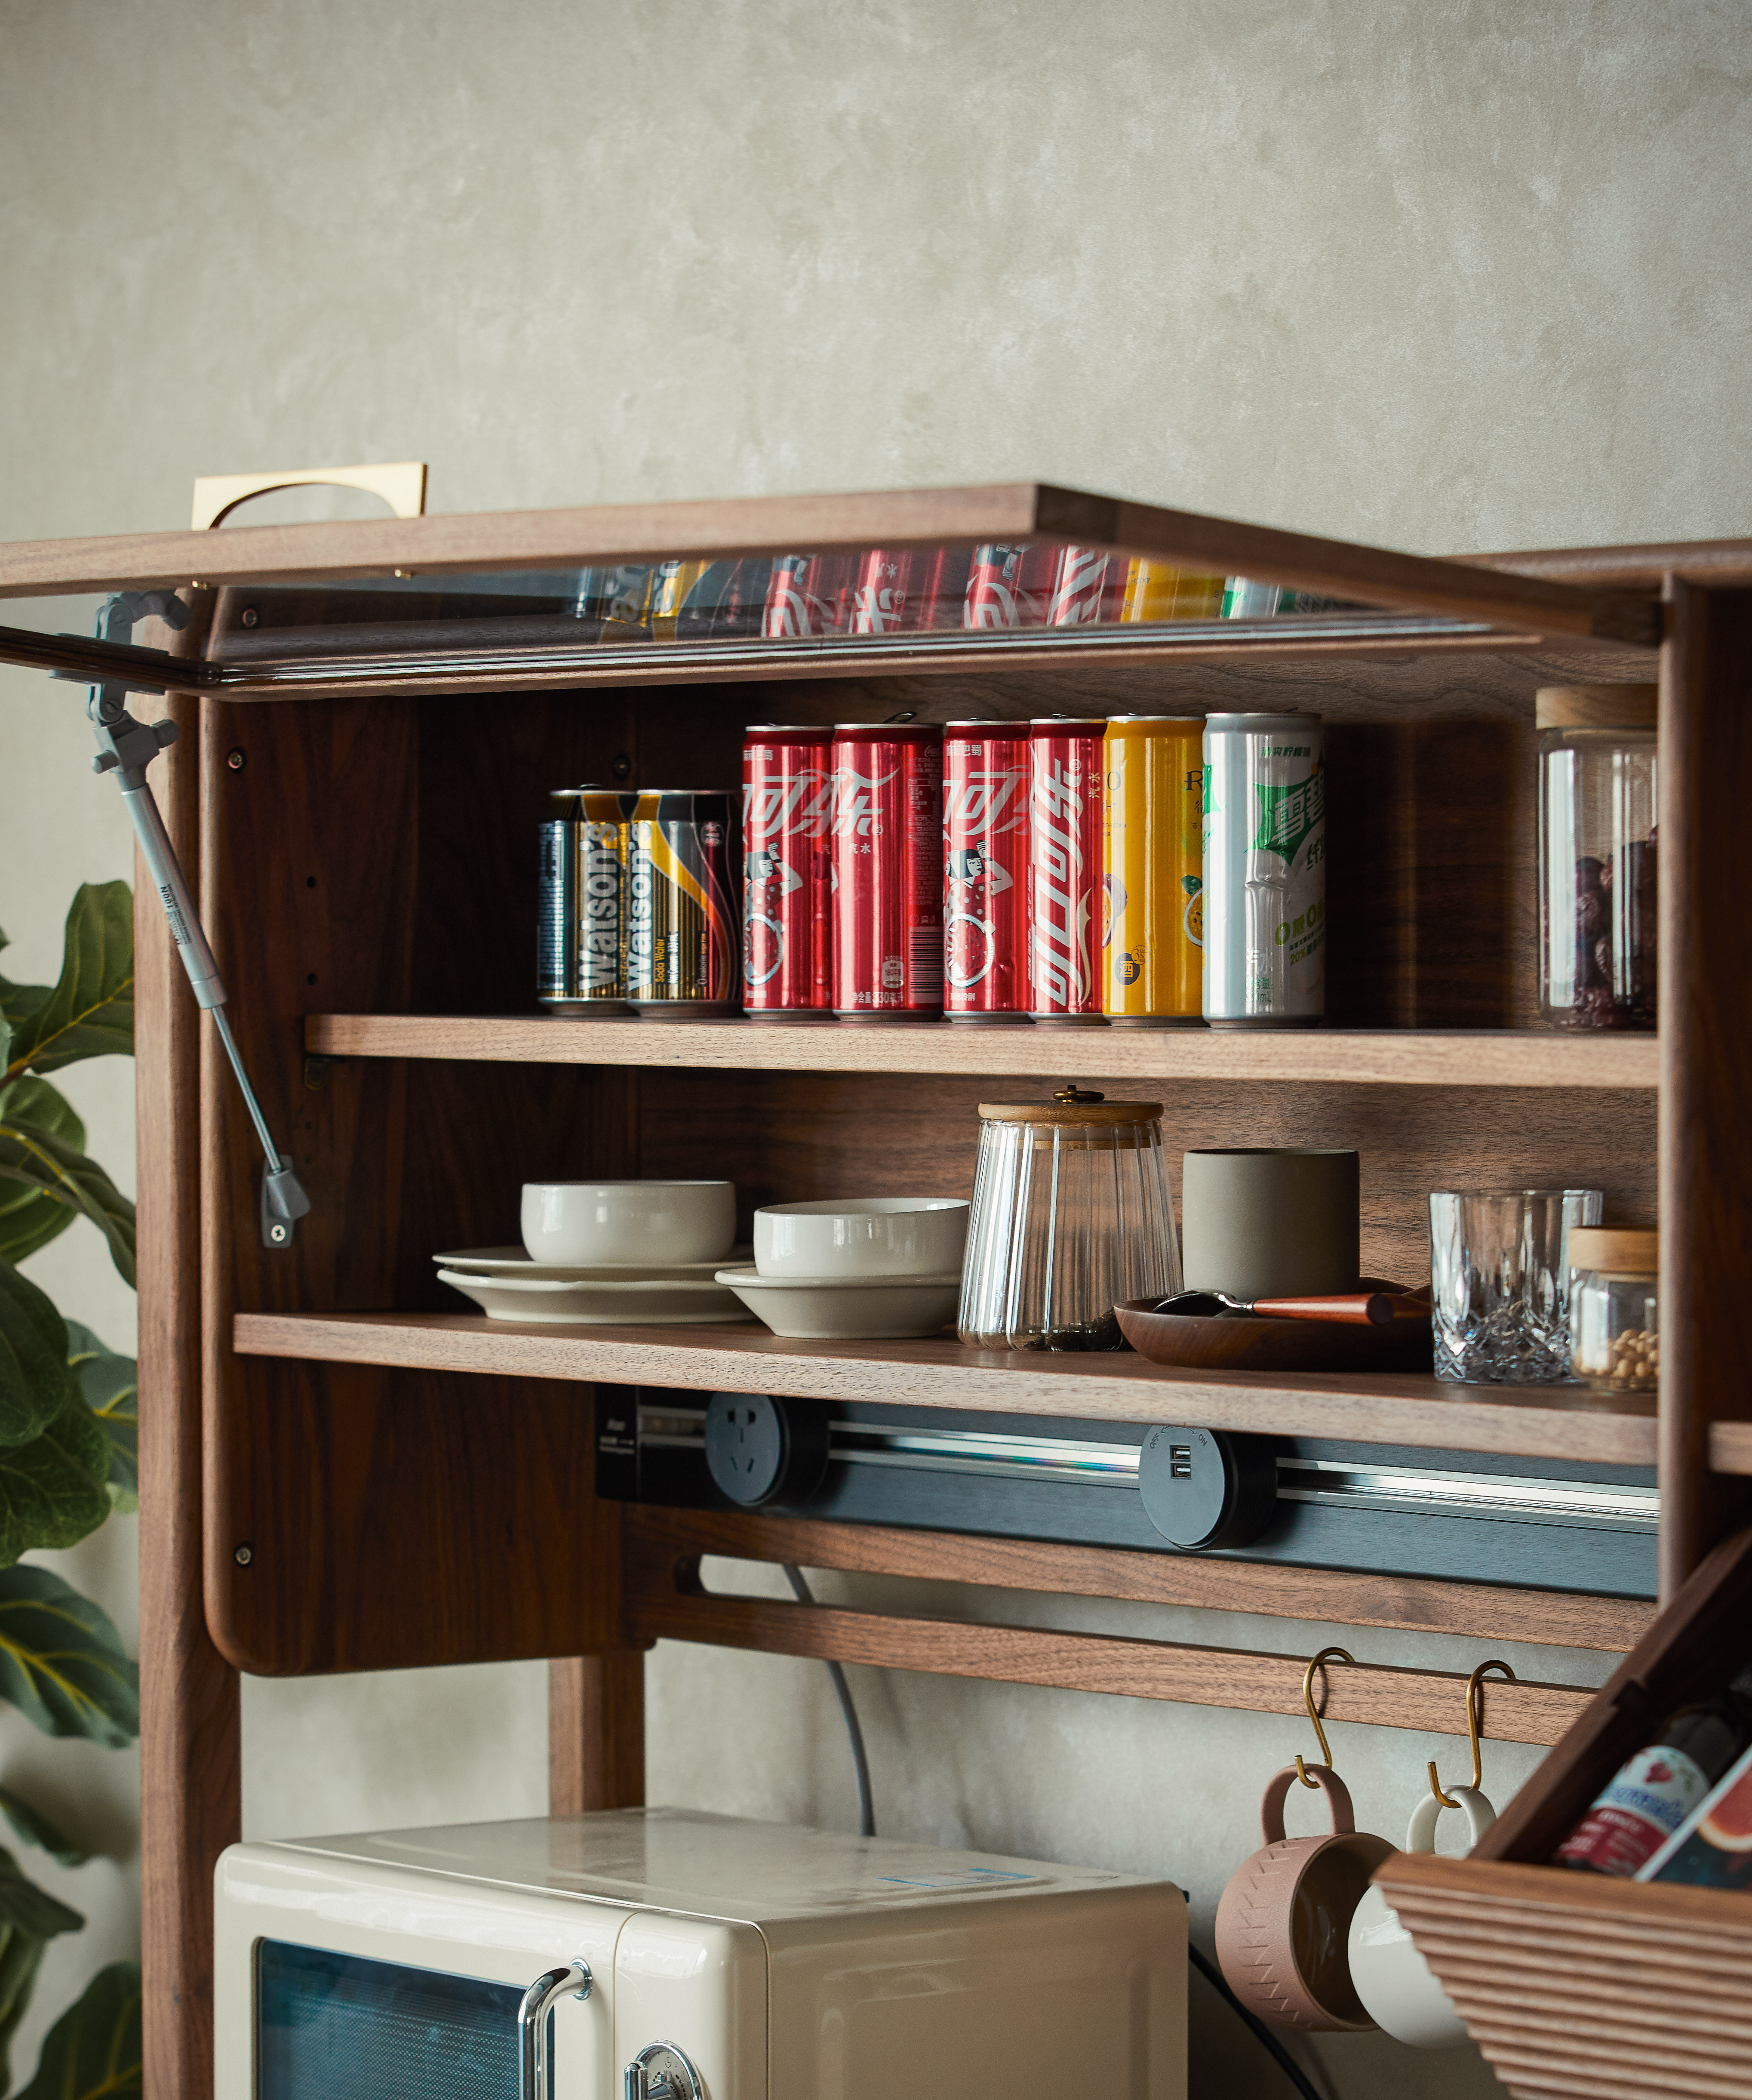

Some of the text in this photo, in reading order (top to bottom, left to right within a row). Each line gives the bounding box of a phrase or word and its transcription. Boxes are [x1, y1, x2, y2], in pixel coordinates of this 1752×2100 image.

[1088, 772, 1101, 798] 汽水
[1271, 773, 1325, 845] 雪碧
[848, 843, 871, 854] 汽水
[1030, 742, 1082, 1006] 可口可乐
[160, 887, 174, 908] 100N
[579, 822, 618, 991] Watson's
[628, 821, 652, 991] Watson's
[655, 938, 665, 983] Soda Water
[1119, 961, 1133, 978] 酒
[1150, 1432, 1159, 1449] OFF
[1198, 1434, 1208, 1447] ON
